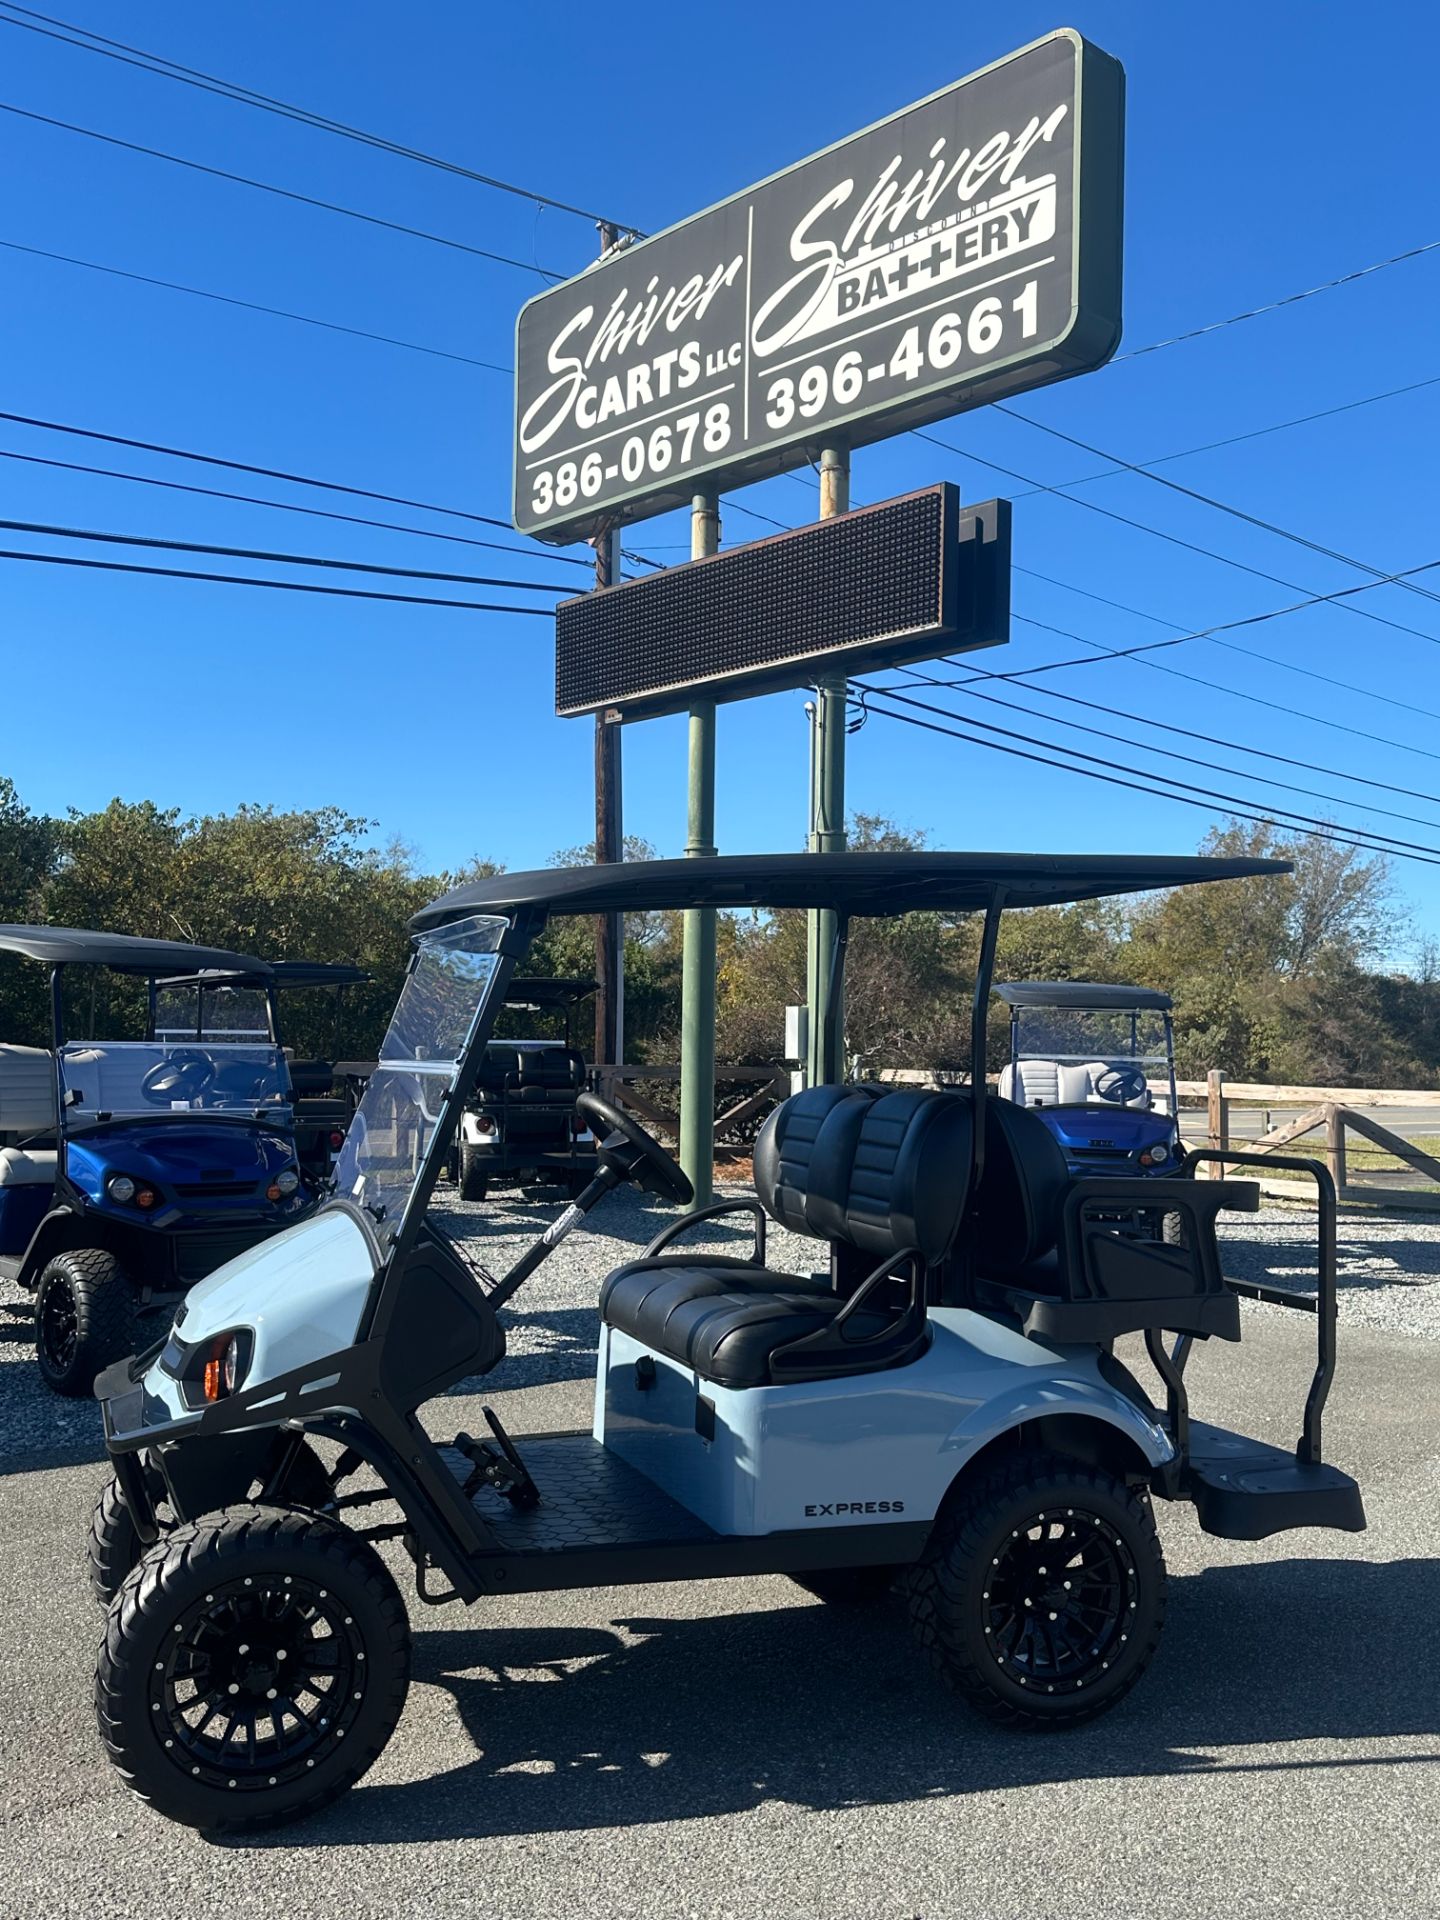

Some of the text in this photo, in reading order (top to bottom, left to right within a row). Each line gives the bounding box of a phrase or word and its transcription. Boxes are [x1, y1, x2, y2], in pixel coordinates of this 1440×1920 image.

[752, 104, 1068, 357] Shiver
[520, 255, 743, 453] Shiver
[575, 341, 742, 429] CARTS LLC
[766, 280, 1038, 429] 396-4661
[531, 402, 731, 514] 386-0678
[804, 1501, 905, 1517] EXPRESS
